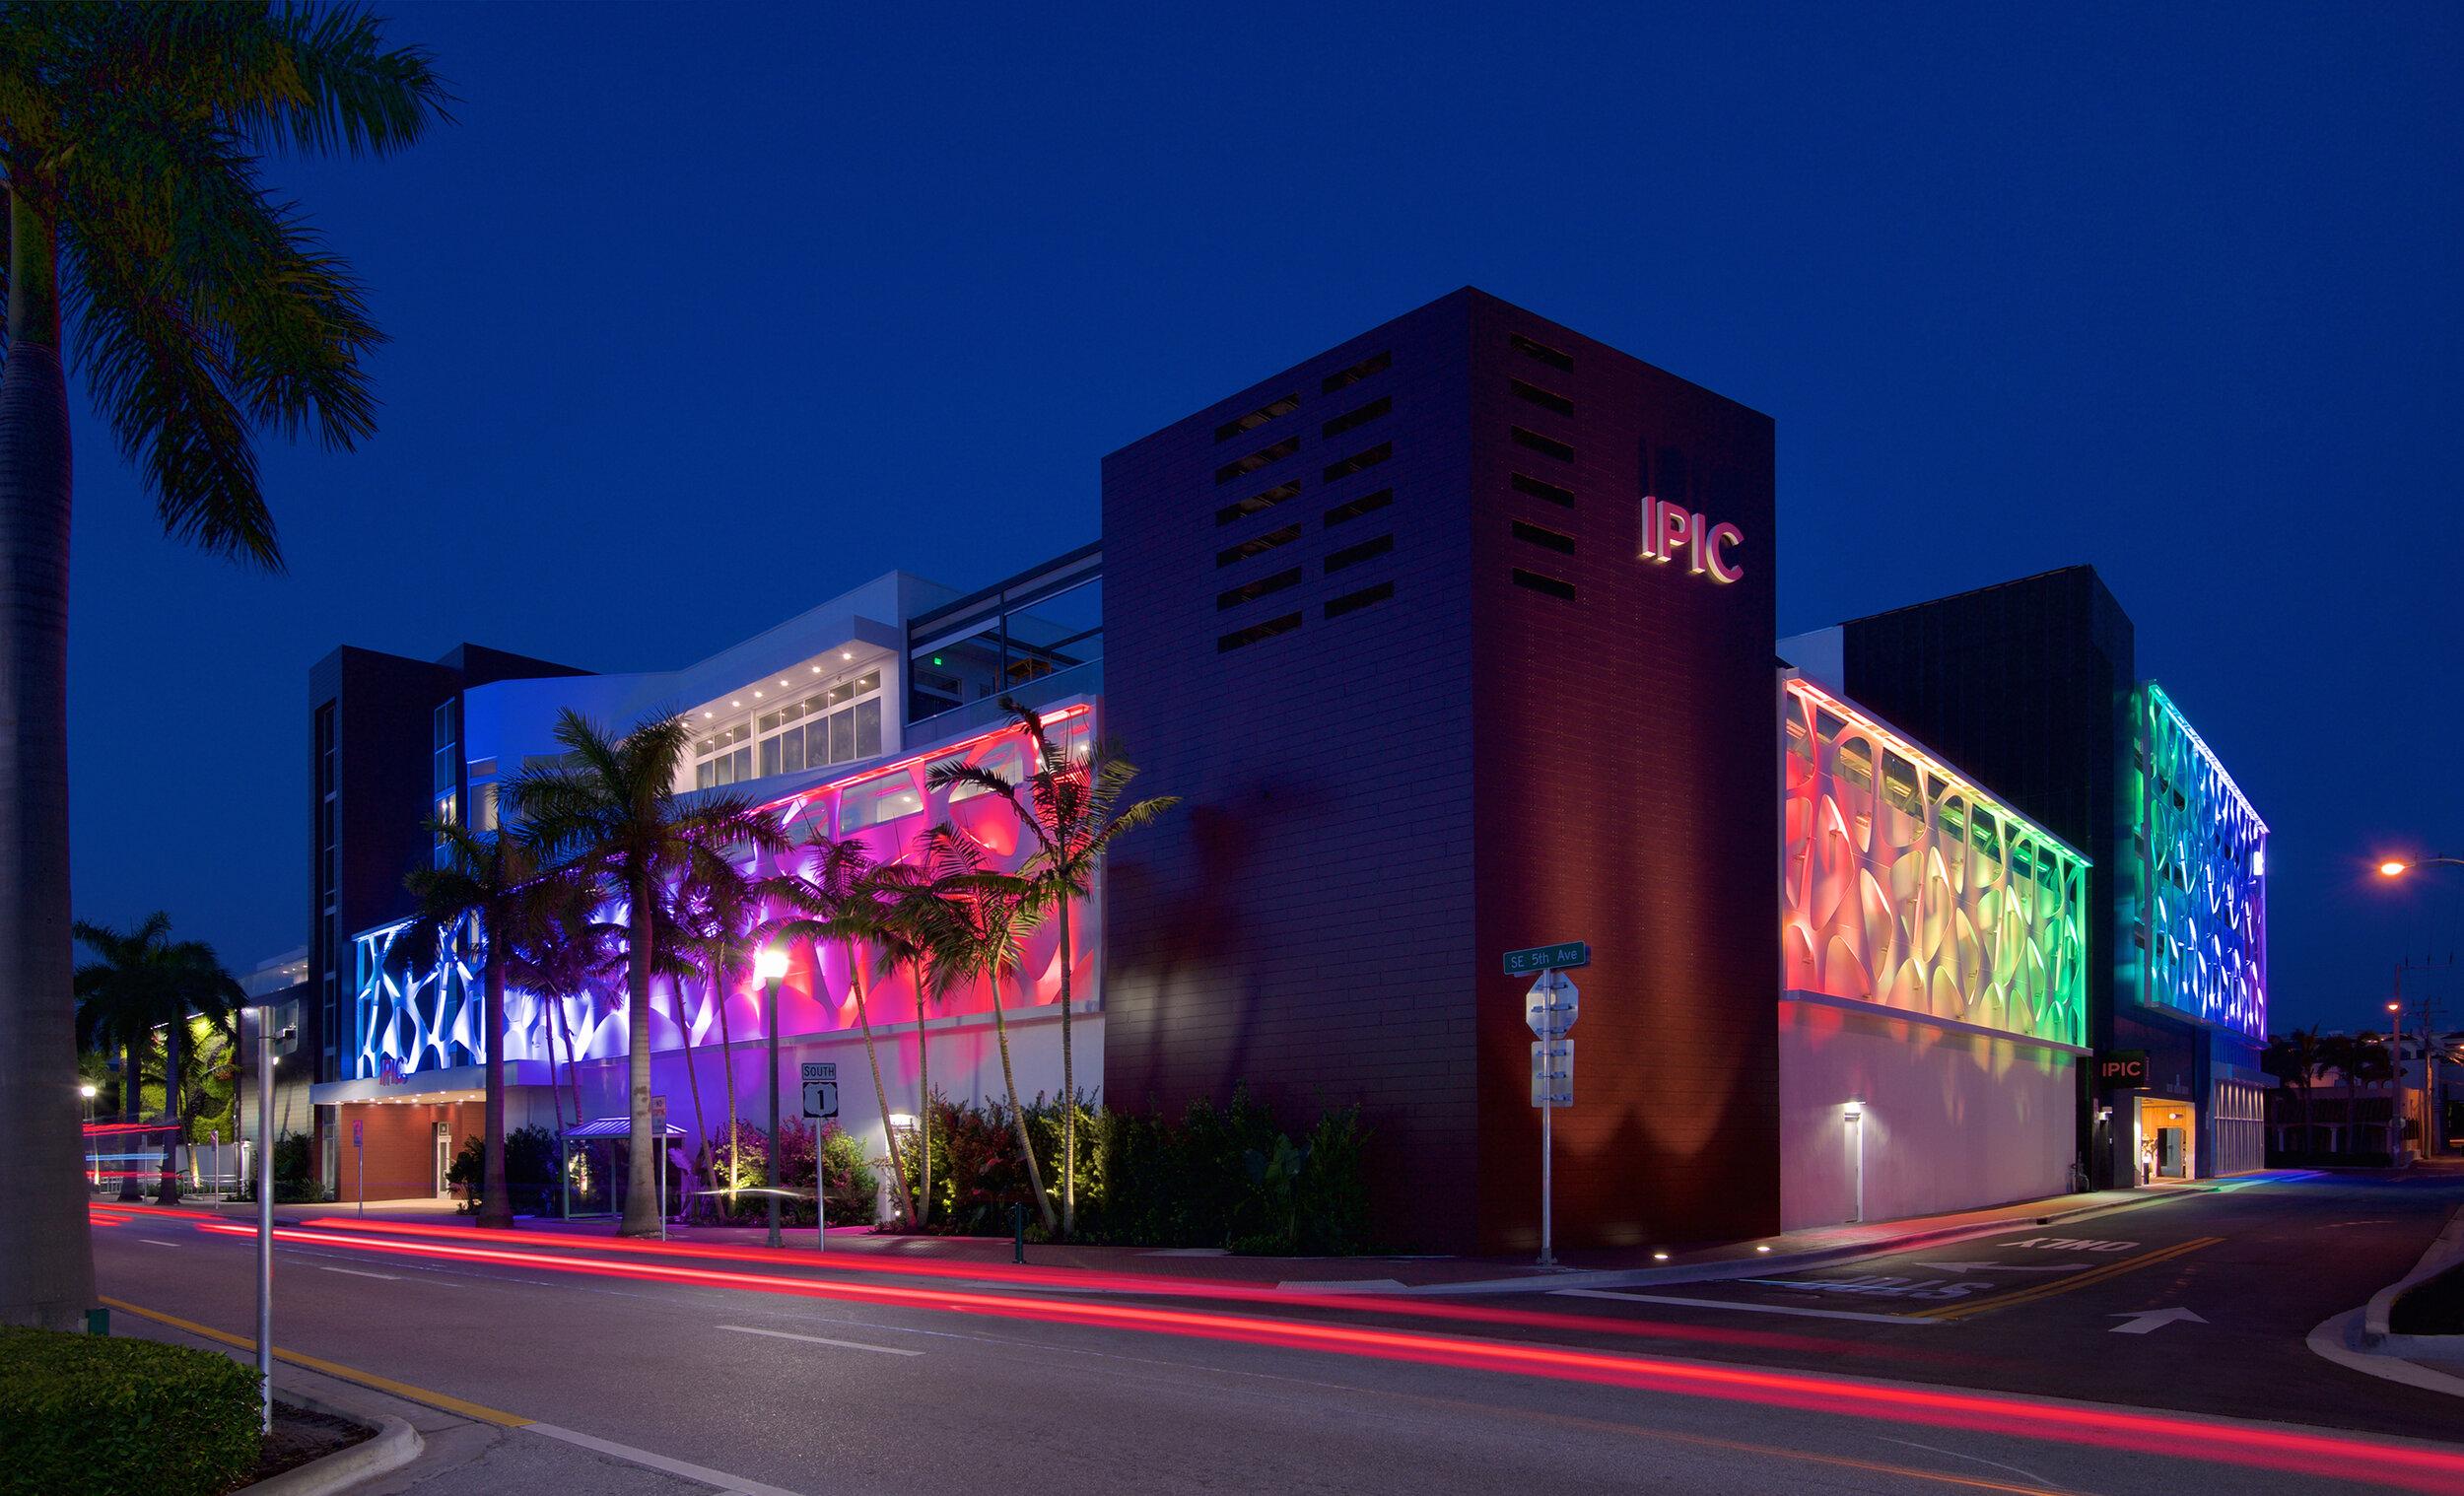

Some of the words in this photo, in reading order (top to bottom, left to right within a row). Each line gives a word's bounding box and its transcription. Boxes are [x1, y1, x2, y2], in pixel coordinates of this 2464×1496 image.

[1641, 496, 1745, 583] IPIC
[1511, 955, 1525, 969] SE
[1532, 952, 1549, 966] 5th
[1557, 948, 1577, 963] Ave
[804, 1065, 835, 1077] SOUTH
[2102, 1061, 2141, 1077] IPIC
[817, 1089, 824, 1111] 1
[1996, 1237, 2141, 1252] ONLY
